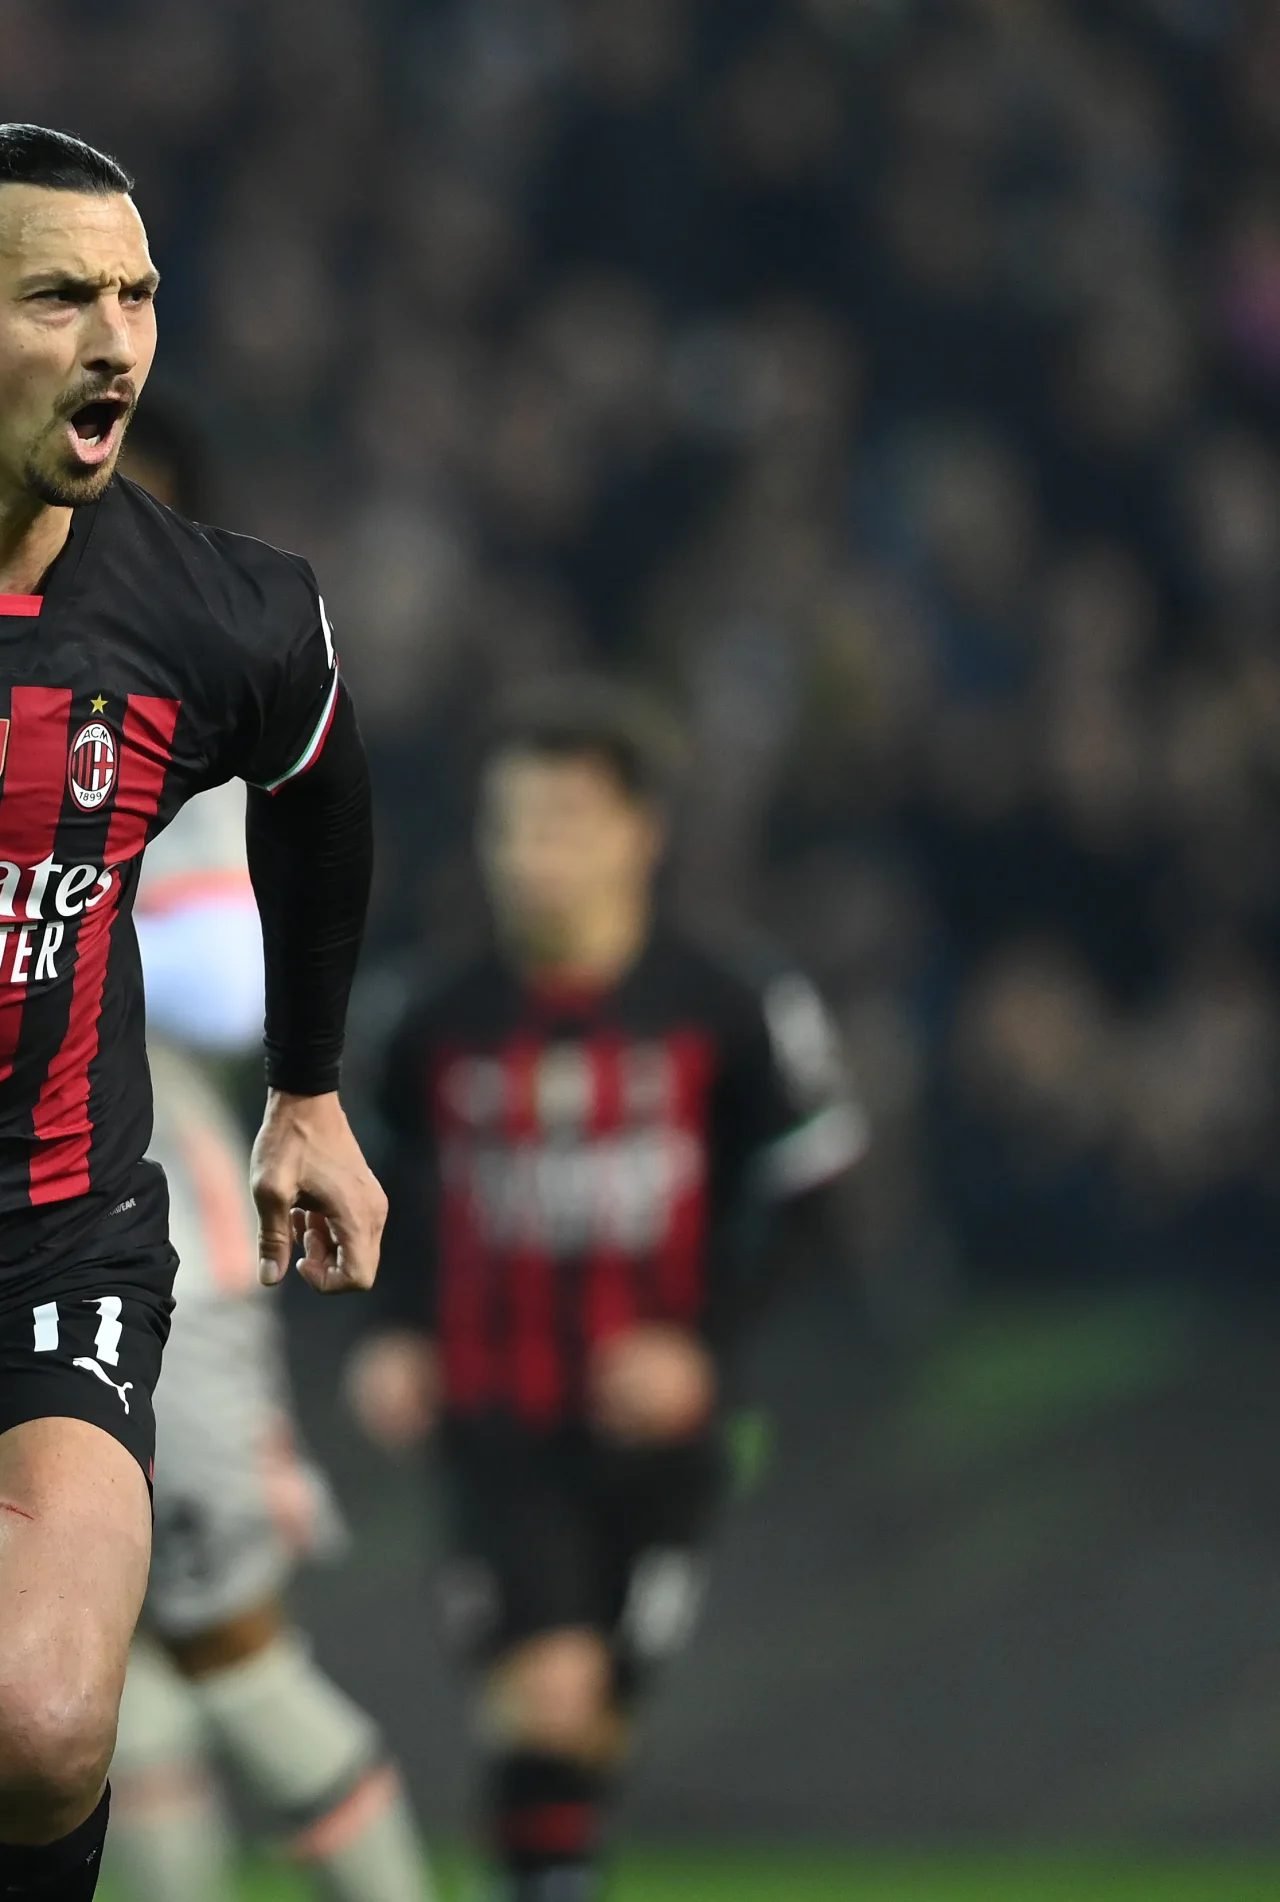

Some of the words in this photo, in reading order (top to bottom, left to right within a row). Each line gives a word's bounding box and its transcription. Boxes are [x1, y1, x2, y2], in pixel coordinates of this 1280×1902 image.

[81, 726, 109, 743] ACM
[79, 791, 102, 802] 1899
[32, 1296, 122, 1367] 11
